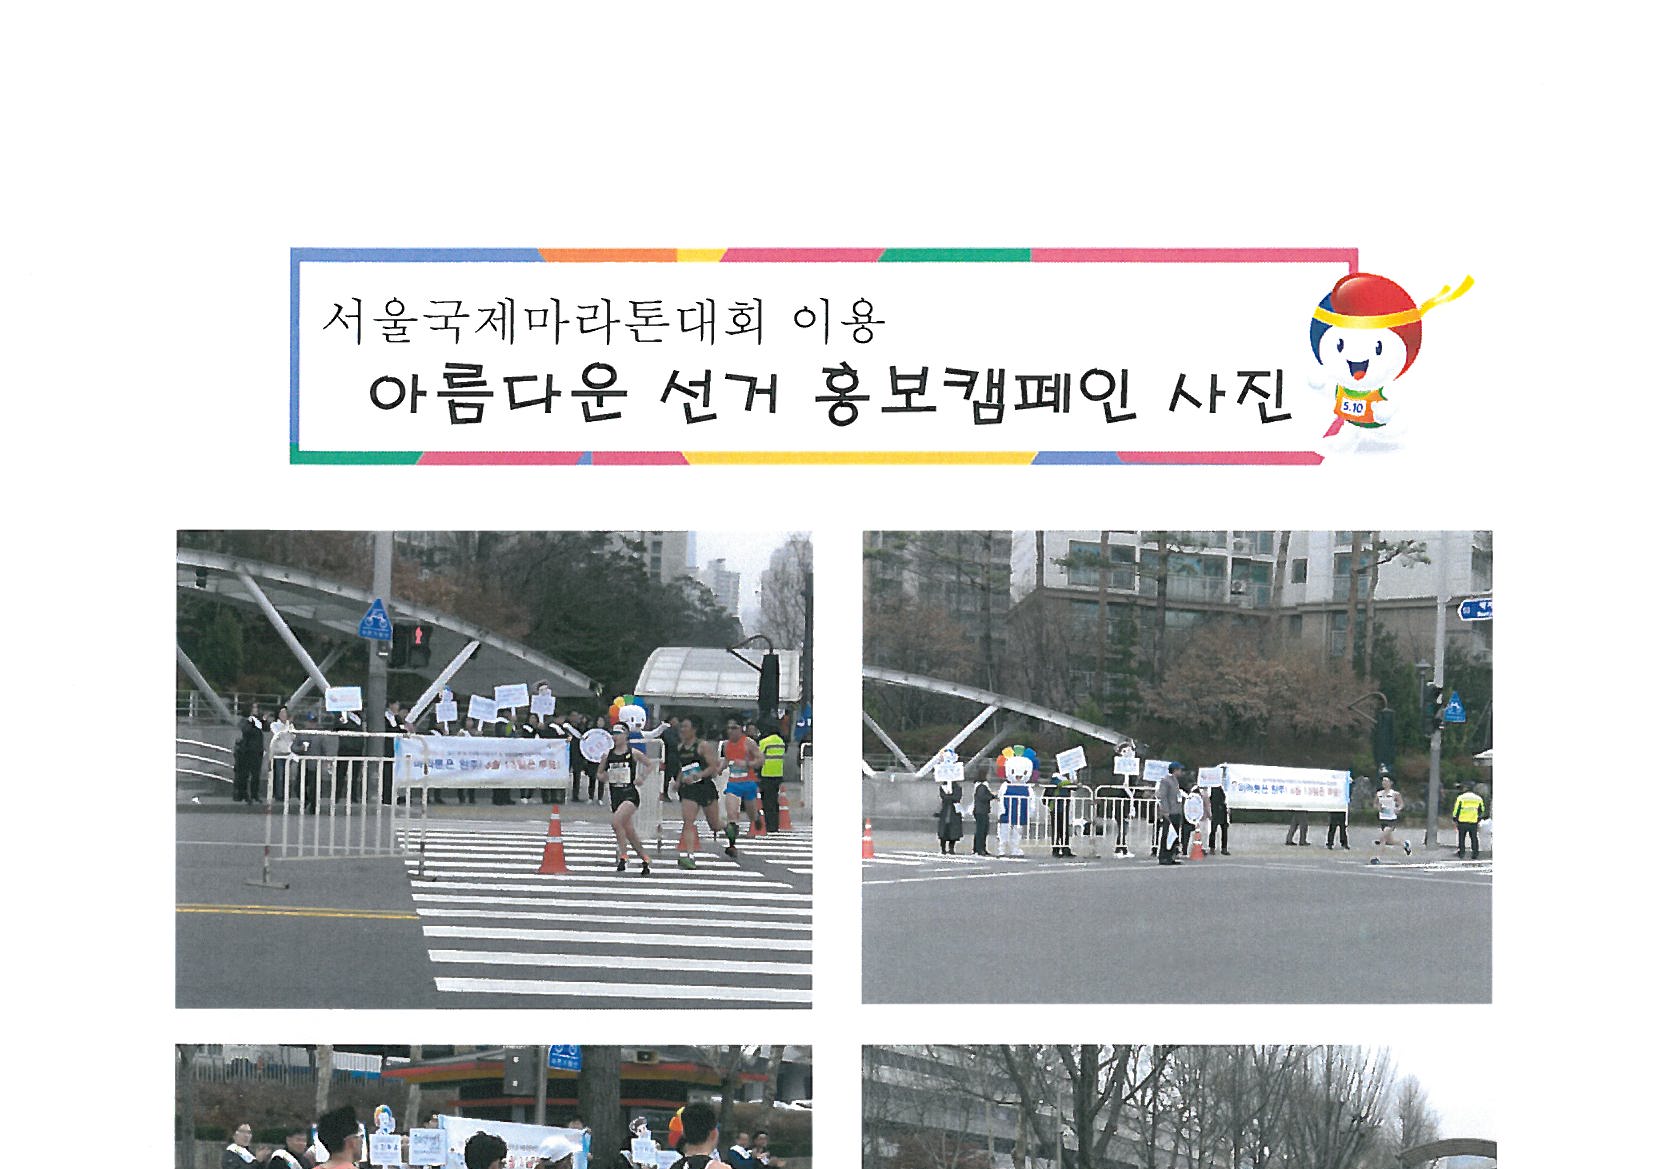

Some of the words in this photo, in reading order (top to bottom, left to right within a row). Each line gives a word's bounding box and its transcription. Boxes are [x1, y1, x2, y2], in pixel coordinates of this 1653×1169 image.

[322, 296, 762, 346] 서울국제마라톤대회
[793, 297, 886, 346] 이용
[369, 361, 628, 425] 아름다운
[660, 369, 777, 425] 선거
[815, 360, 1137, 427] 홍보캠페인
[1168, 368, 1293, 425] 사진
[1343, 401, 1364, 414] 5.10
